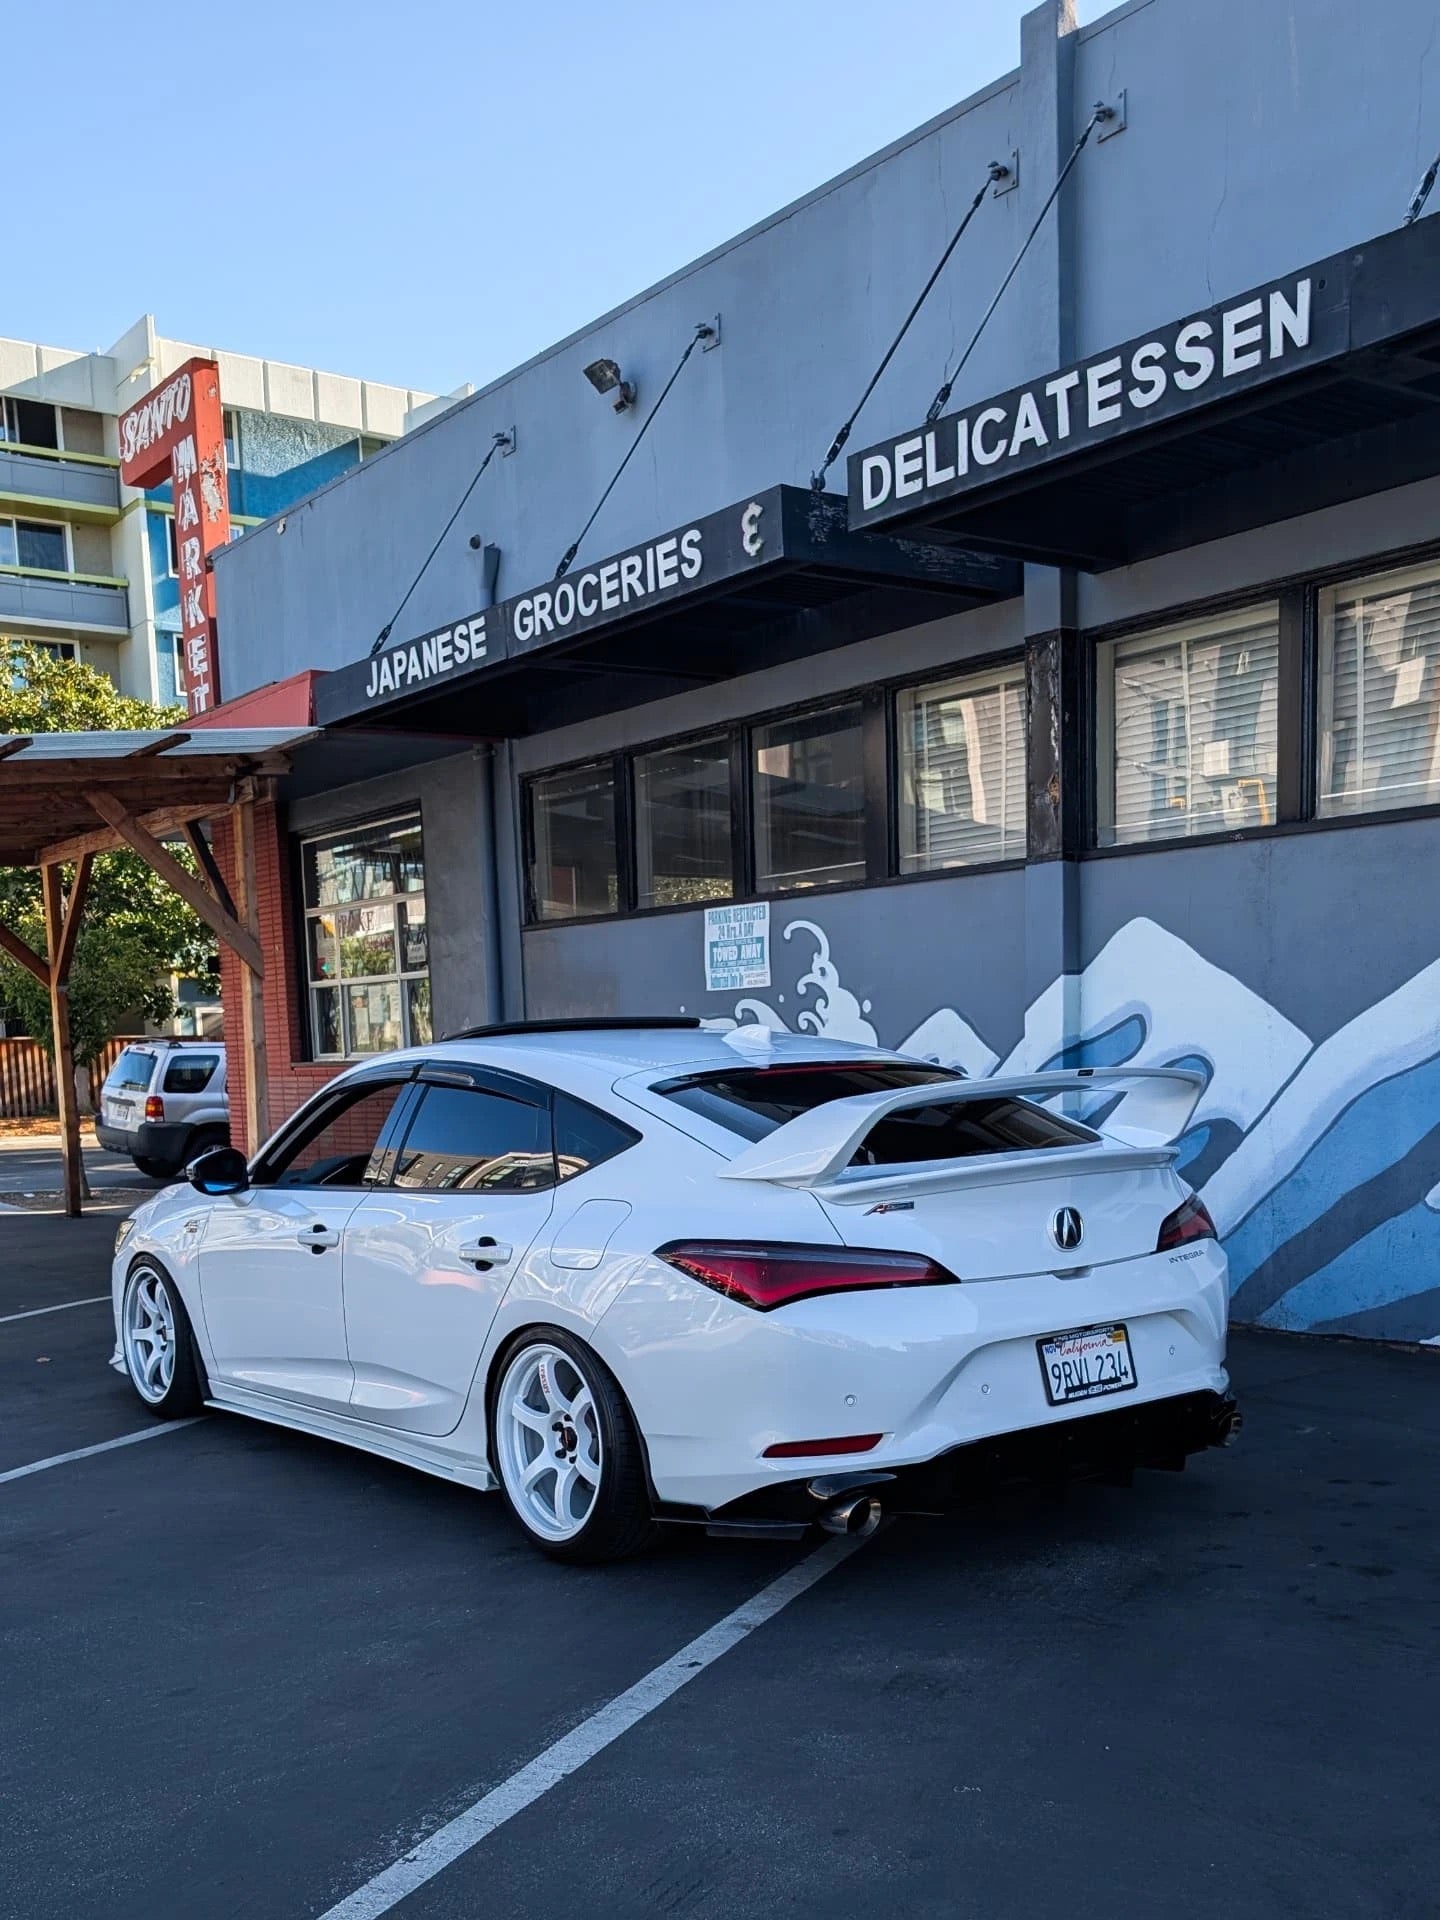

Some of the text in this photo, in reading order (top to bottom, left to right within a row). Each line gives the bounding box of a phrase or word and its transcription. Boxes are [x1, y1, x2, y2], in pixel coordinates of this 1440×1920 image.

[119, 373, 191, 463] SANTO
[862, 277, 1311, 511] DELICATESSEN
[173, 434, 209, 715] MARKET
[366, 616, 487, 698] JAPANESE
[513, 529, 702, 641] GROCERIES
[708, 905, 766, 925] PARKING RESTRICTED
[712, 945, 738, 962] TOWED
[741, 943, 762, 960] AWAY
[1168, 1249, 1205, 1264] INTEGRA
[1060, 1338, 1113, 1356] California
